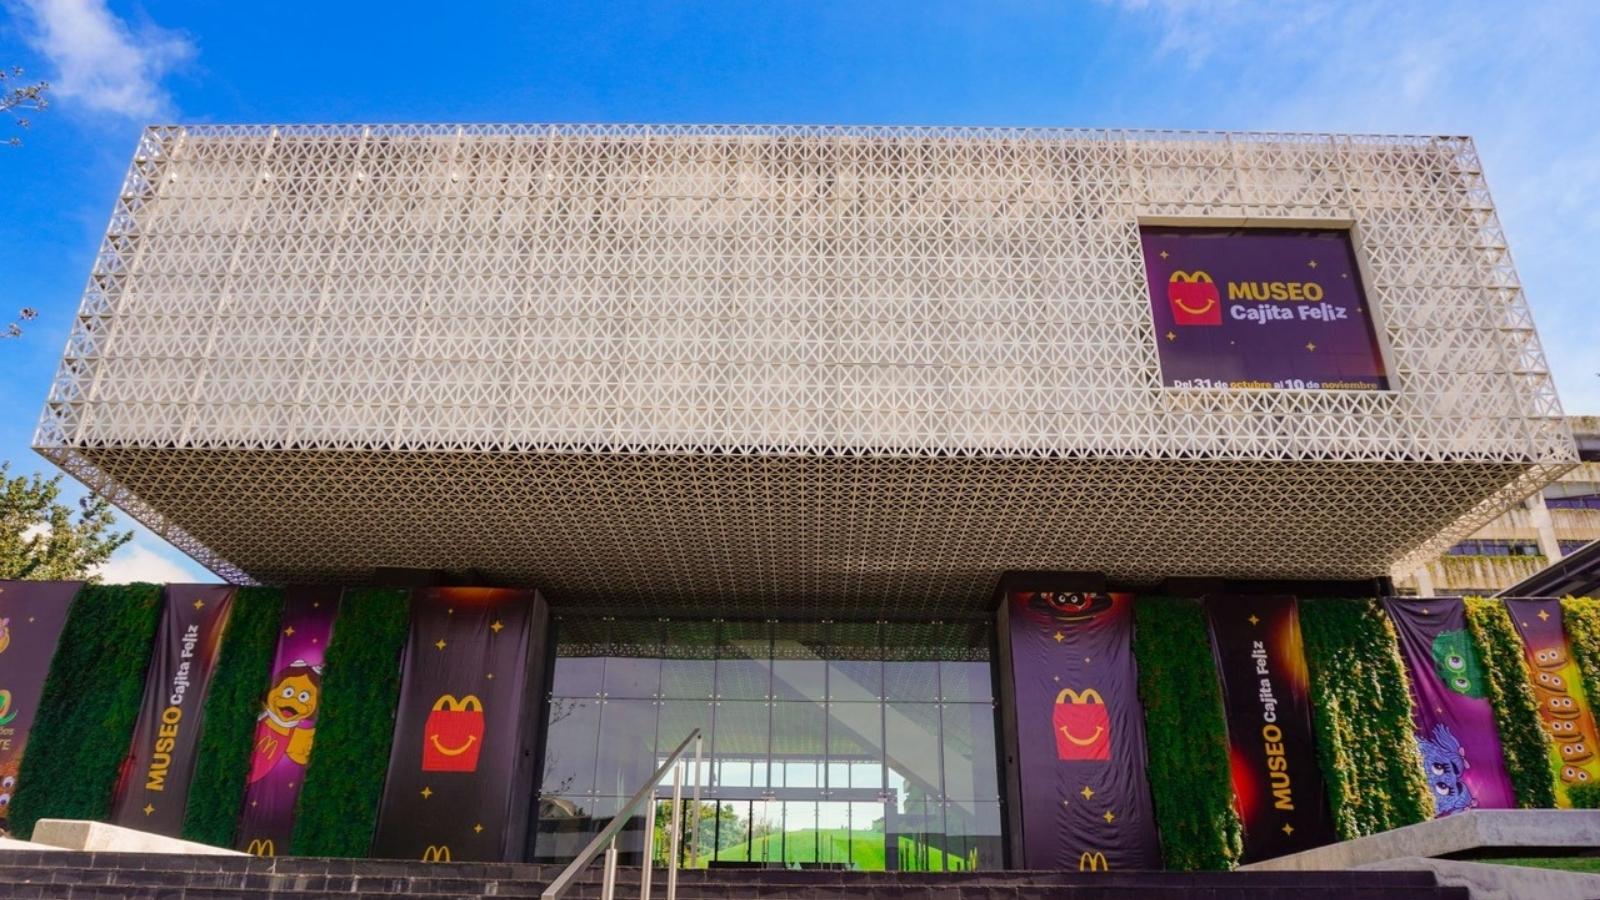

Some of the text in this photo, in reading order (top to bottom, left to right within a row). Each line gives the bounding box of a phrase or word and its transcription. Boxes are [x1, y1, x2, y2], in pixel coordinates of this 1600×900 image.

[1228, 281, 1324, 301] MUSEO
[1230, 302, 1348, 325] Cajita Feliz
[1173, 378, 1378, 390] Del 31 de octubre al 10 de noviembre
[145, 623, 199, 792] MUSEO Cajita Feliz
[1251, 640, 1295, 811] MUSEO Cajita Feliz
